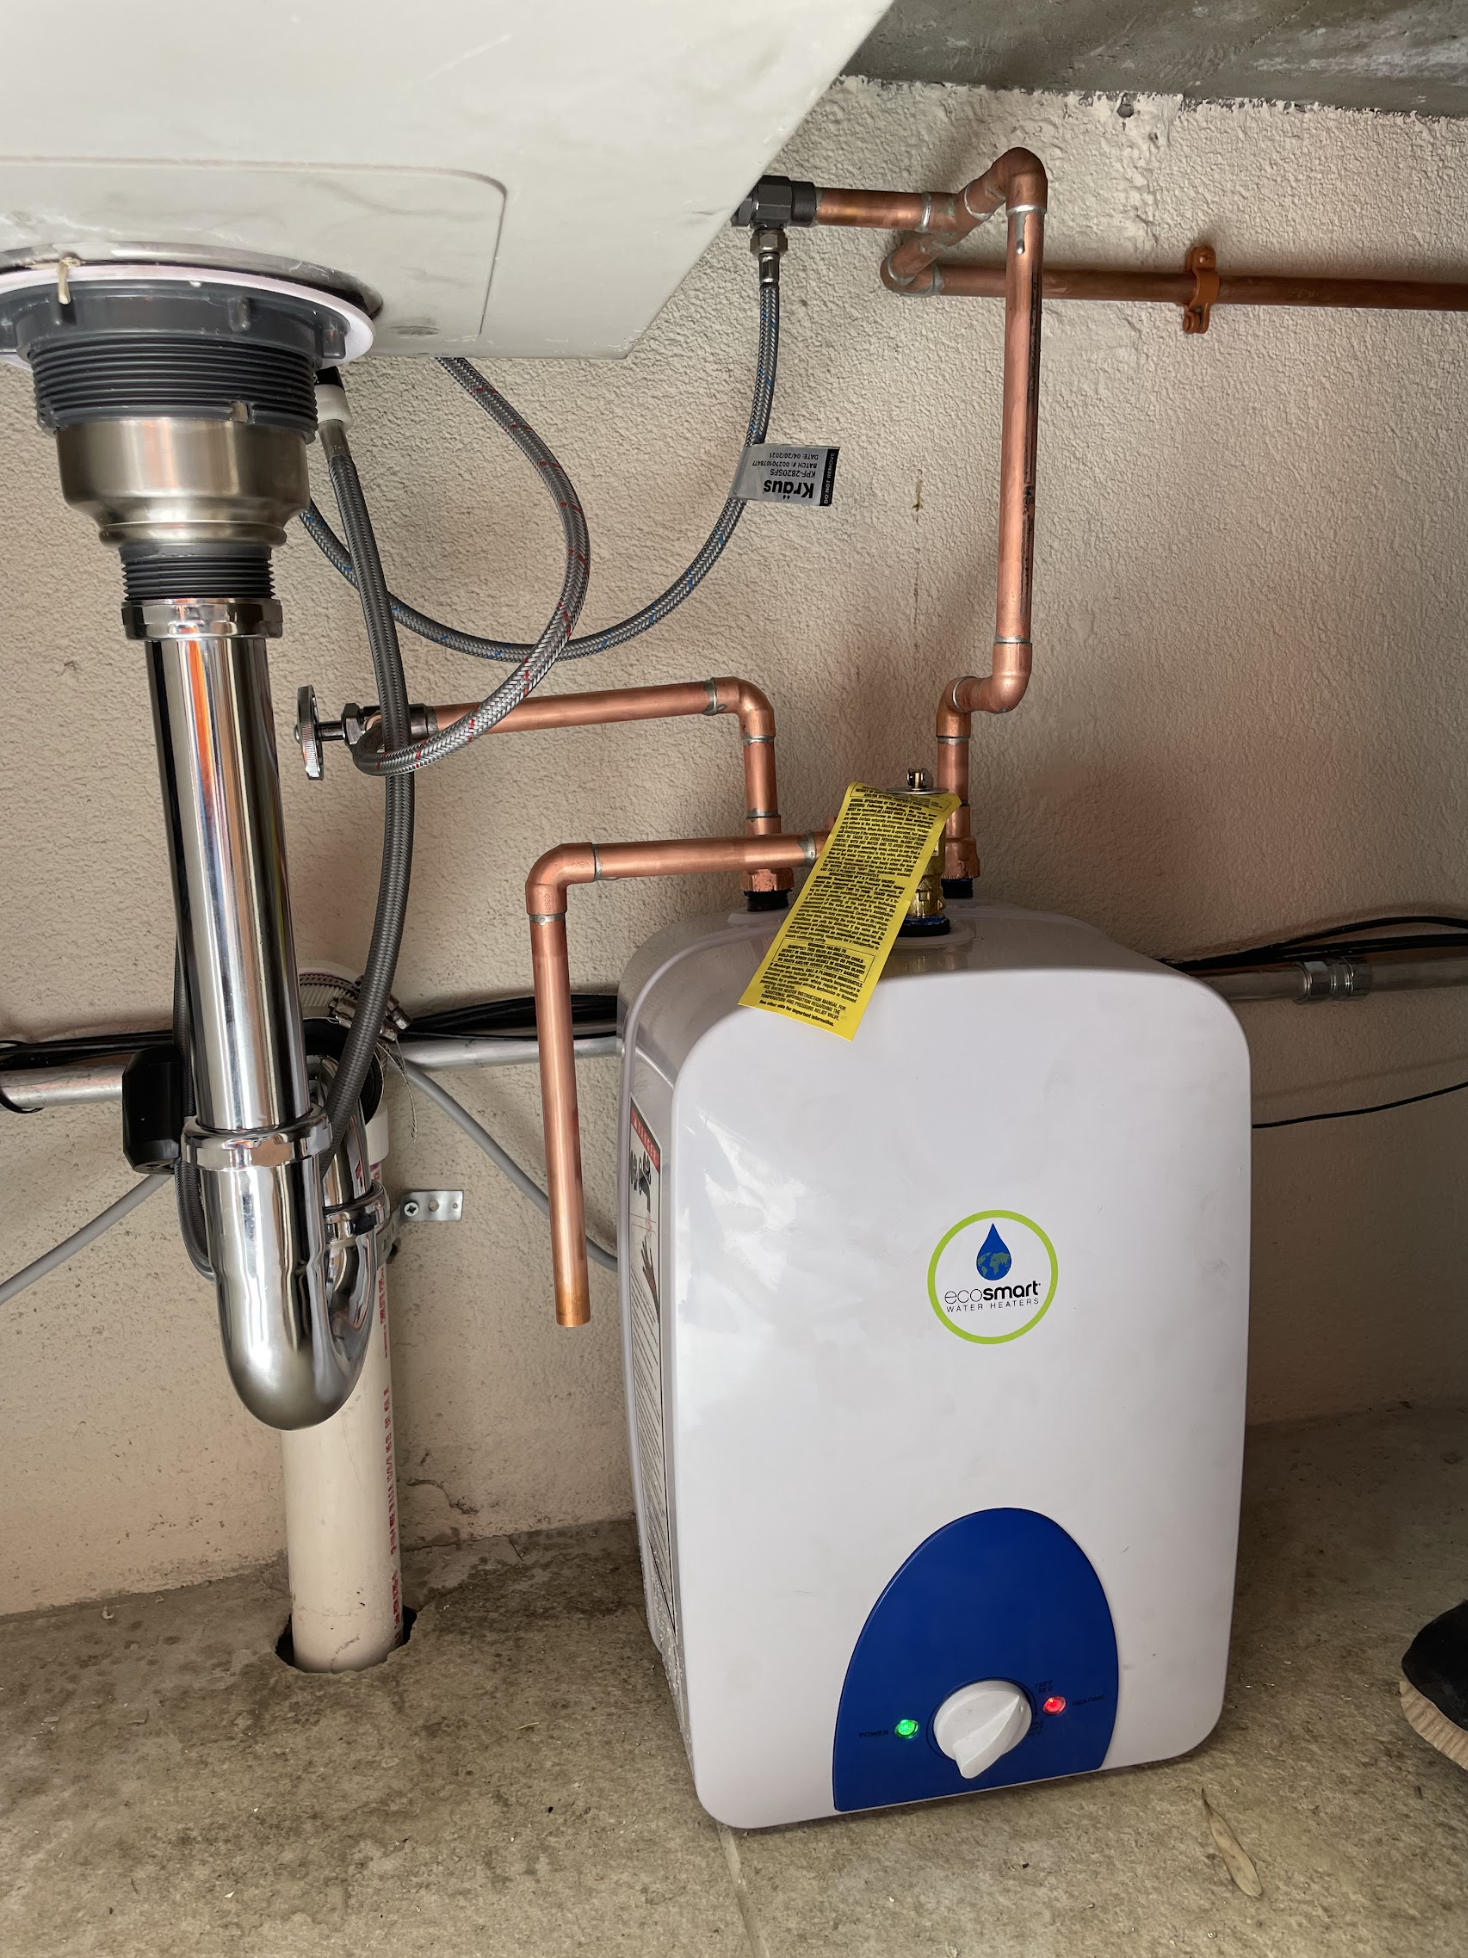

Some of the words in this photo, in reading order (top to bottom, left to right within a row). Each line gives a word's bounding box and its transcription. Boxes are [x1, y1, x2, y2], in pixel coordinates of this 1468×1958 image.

[944, 1280, 1039, 1304] ecosmart
[947, 1303, 983, 1313] WATER
[990, 1298, 1039, 1309] HEATERS
